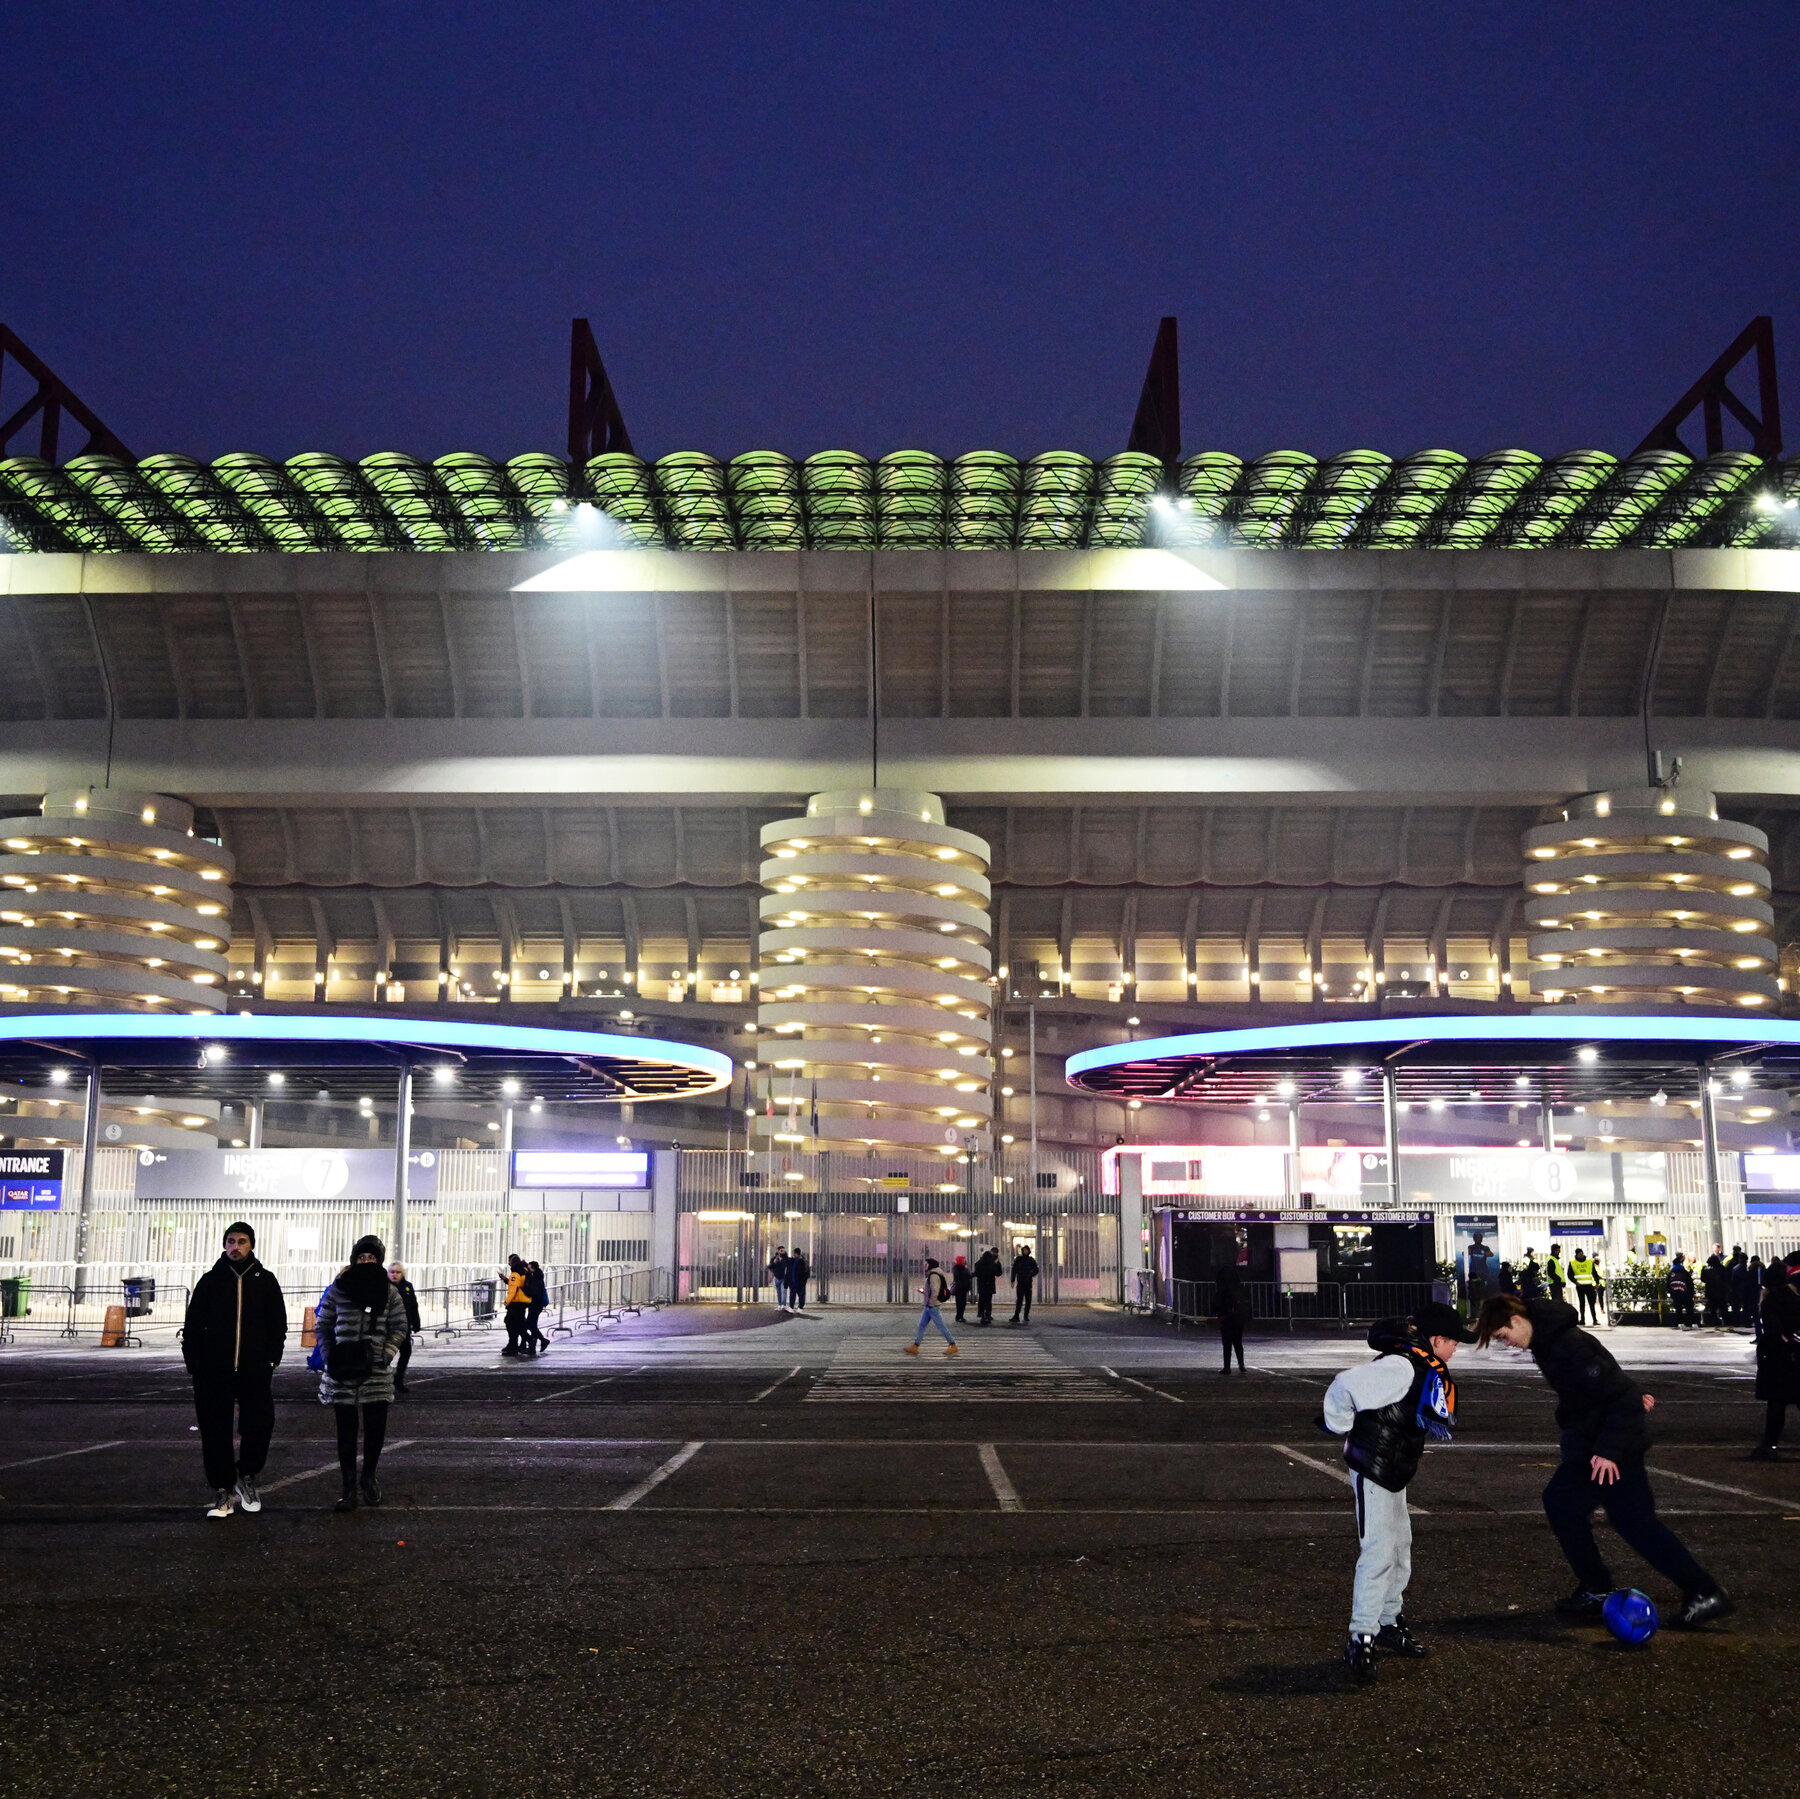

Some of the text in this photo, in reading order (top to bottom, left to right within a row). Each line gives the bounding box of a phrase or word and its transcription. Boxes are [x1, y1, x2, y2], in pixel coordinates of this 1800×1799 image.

[0, 1157, 50, 1173] NTRANCE
[224, 1155, 302, 1176] INGREO
[320, 1159, 333, 1190] 7
[1450, 1157, 1528, 1178] INGREO
[1548, 1161, 1561, 1192] 8
[1472, 1177, 1508, 1197] GATE
[1188, 1211, 1235, 1220] CUSTOMER BOX
[1280, 1211, 1328, 1221] CUSTOMER BOX
[1371, 1212, 1419, 1221] CUSTOMER BOX
